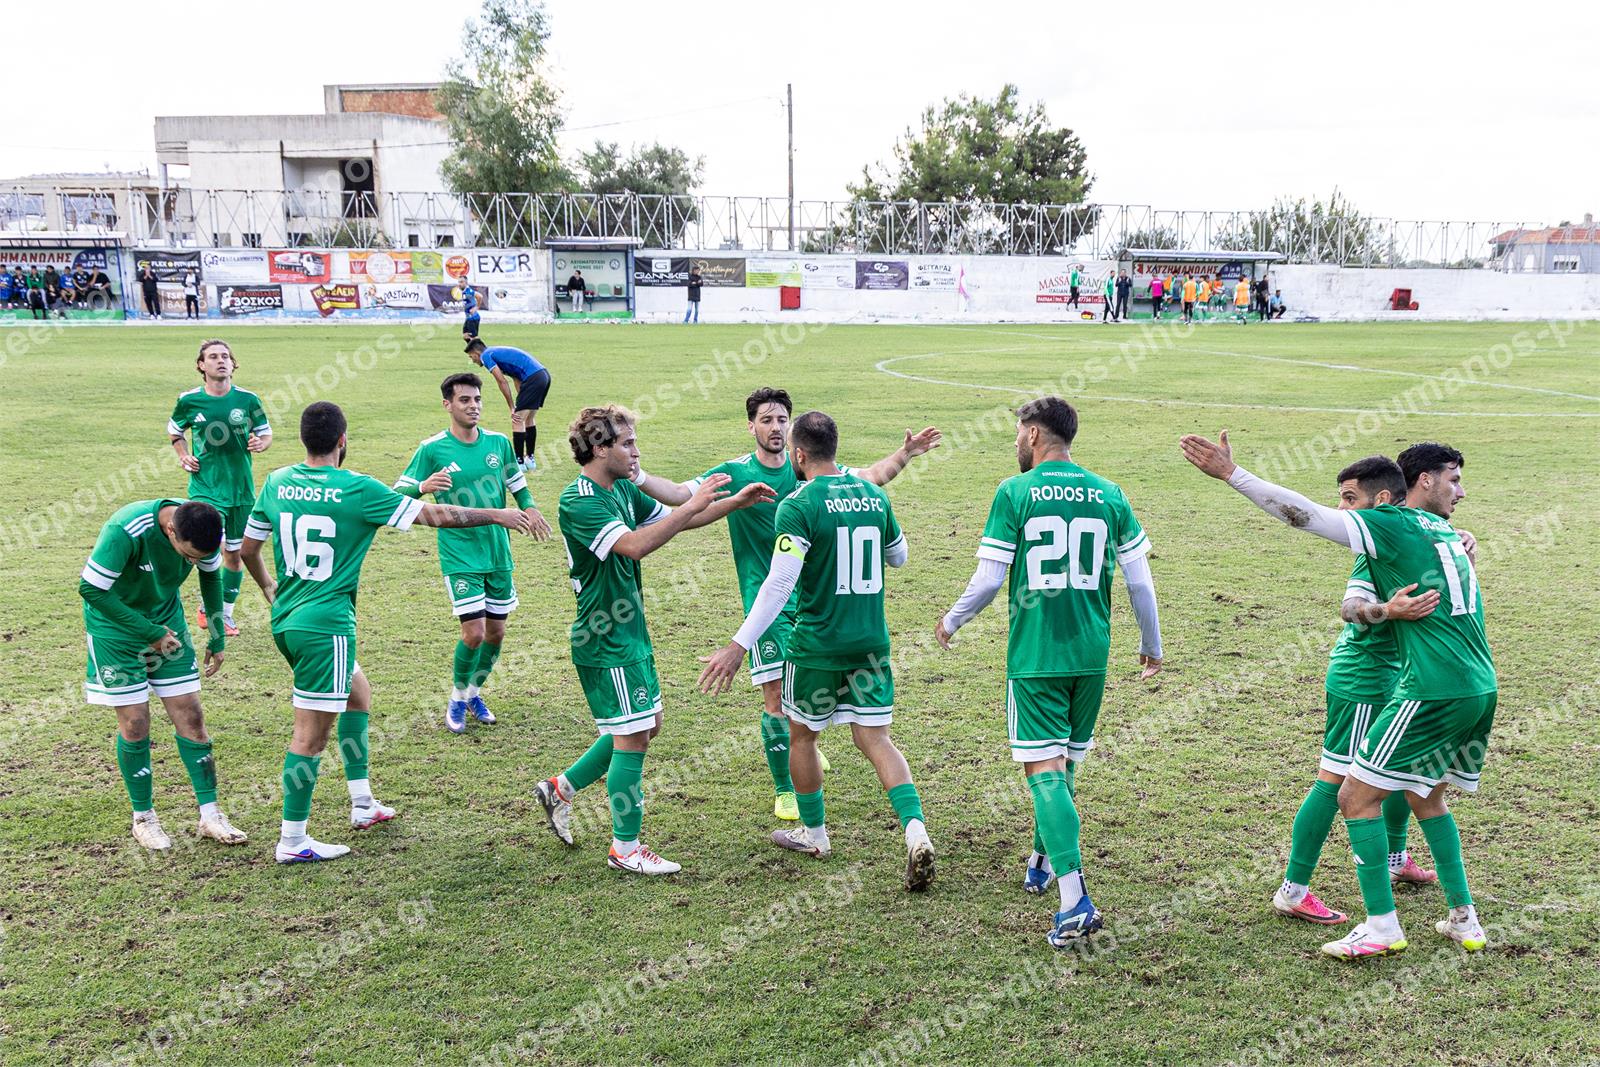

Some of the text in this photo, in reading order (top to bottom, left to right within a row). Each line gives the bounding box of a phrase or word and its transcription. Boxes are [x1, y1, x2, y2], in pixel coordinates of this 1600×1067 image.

[277, 485, 342, 503] RODOS FC
[825, 497, 884, 513] RODOS FC
[1030, 485, 1105, 504] RODOS FC
[279, 512, 336, 582] 16
[779, 536, 792, 552] C
[835, 526, 883, 595] 10
[1024, 515, 1108, 590] 20
[1434, 540, 1477, 616] 17
